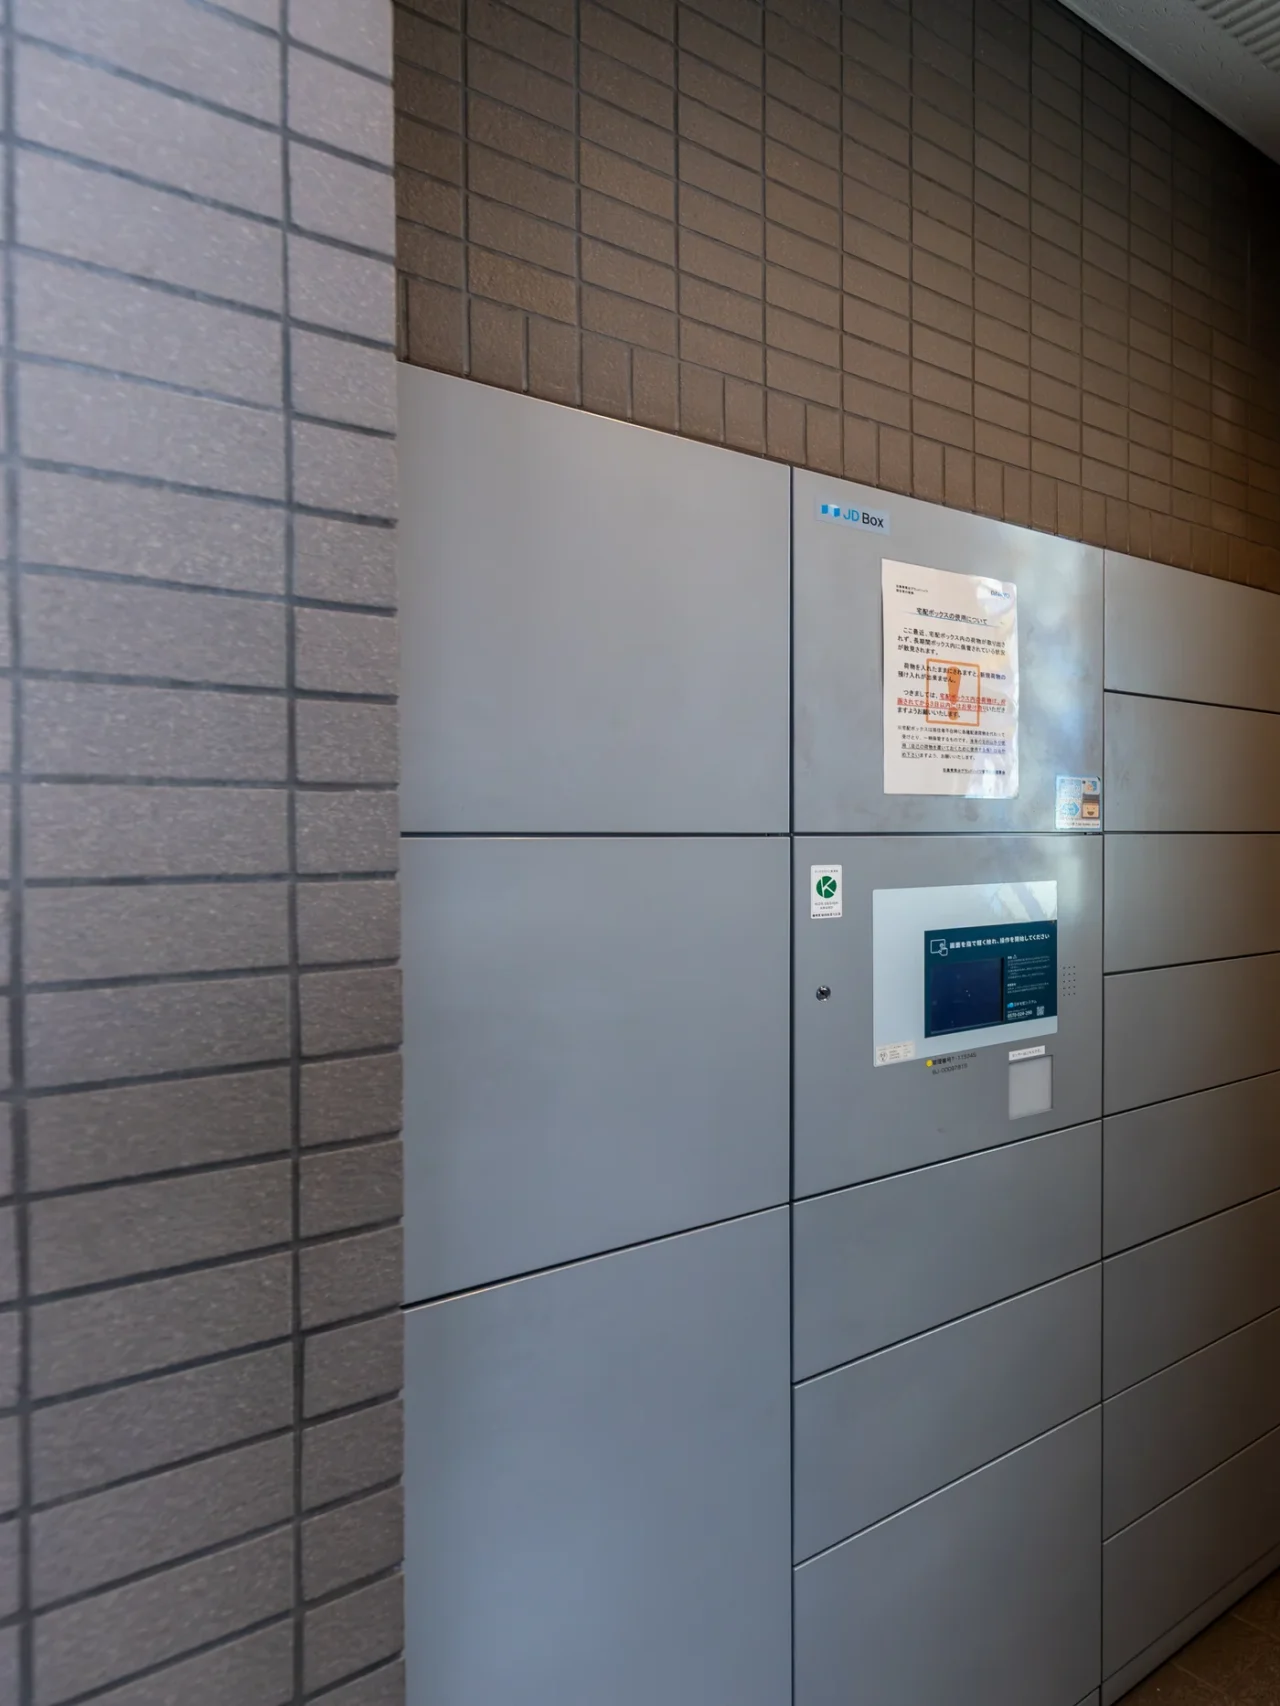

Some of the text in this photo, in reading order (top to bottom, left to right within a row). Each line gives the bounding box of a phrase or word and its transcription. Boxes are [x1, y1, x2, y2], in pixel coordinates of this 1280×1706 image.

[843, 509, 884, 528] JD Box
[916, 607, 988, 625] 宅配ボックスの使用について
[897, 645, 939, 656] が散見されます。
[949, 933, 1050, 949] 画面を指で軽く触れ、操作を開始してください
